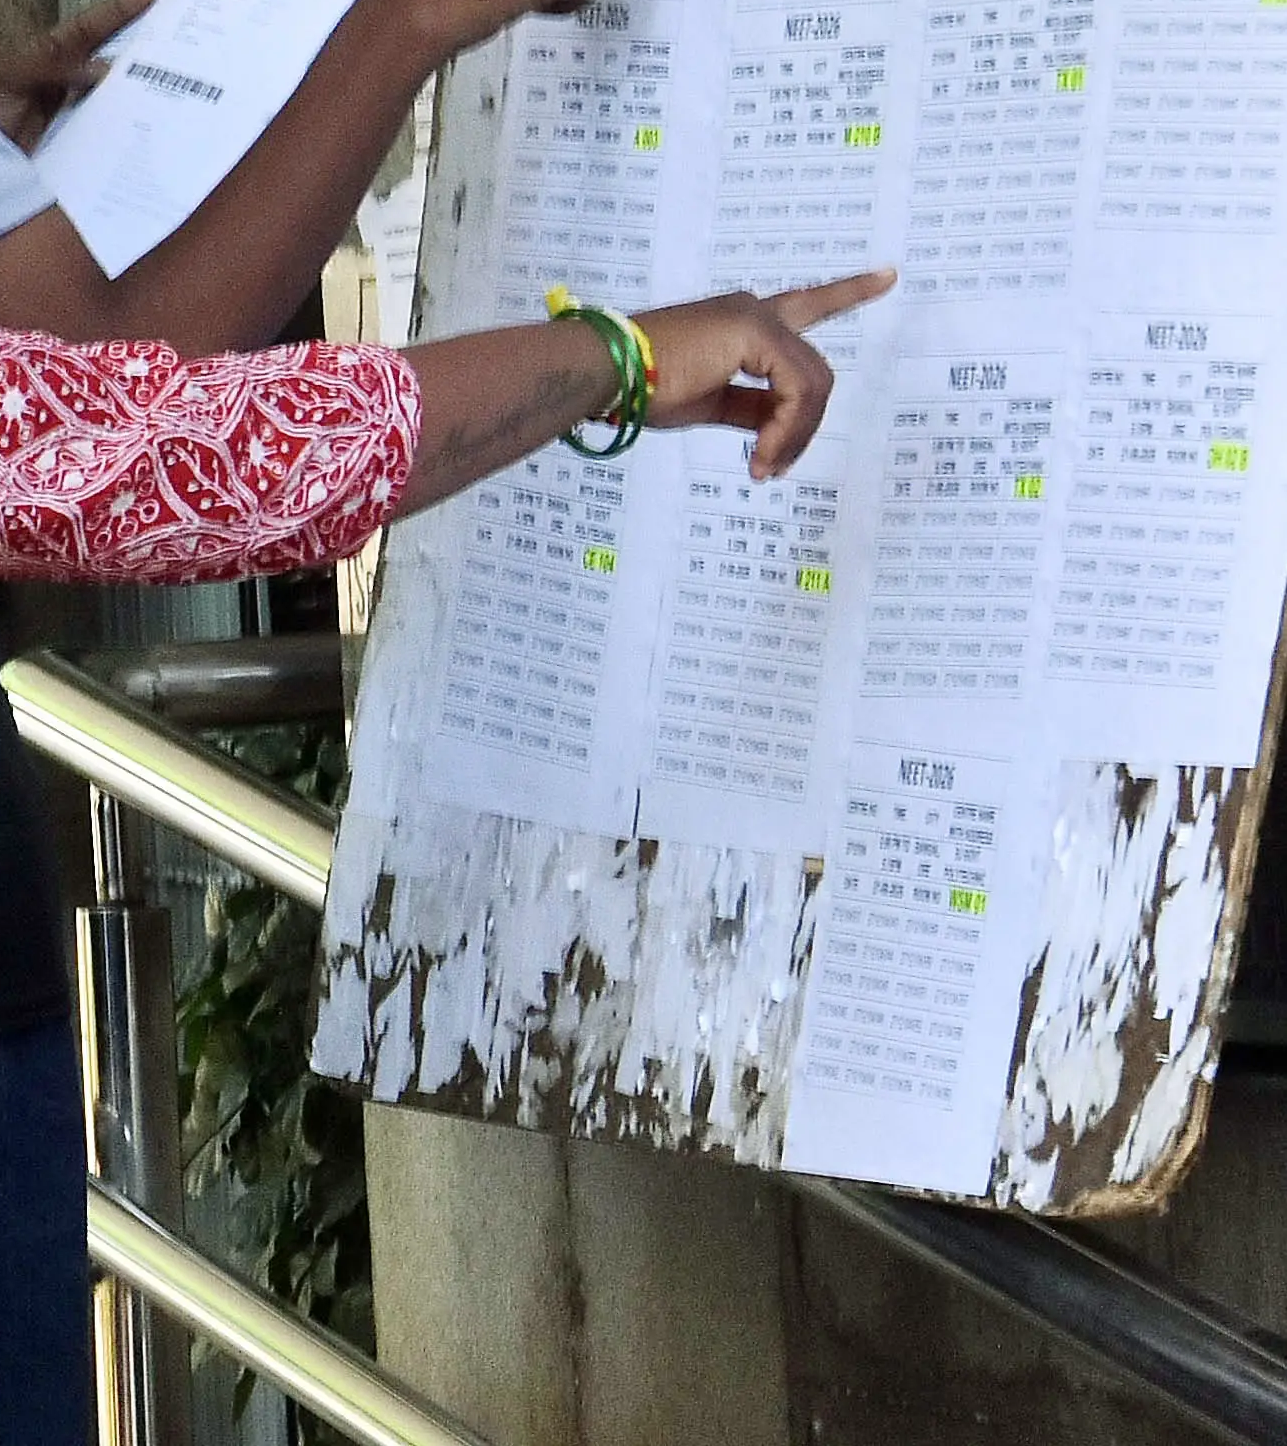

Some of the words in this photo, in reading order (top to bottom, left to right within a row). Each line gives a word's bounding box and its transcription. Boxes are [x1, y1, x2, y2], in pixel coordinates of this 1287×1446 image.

[784, 13, 841, 42] NEET-2026
[1145, 322, 1208, 351] NEET-2026
[948, 362, 1007, 391] NEET-2026
[898, 755, 956, 791] NEET-2026
